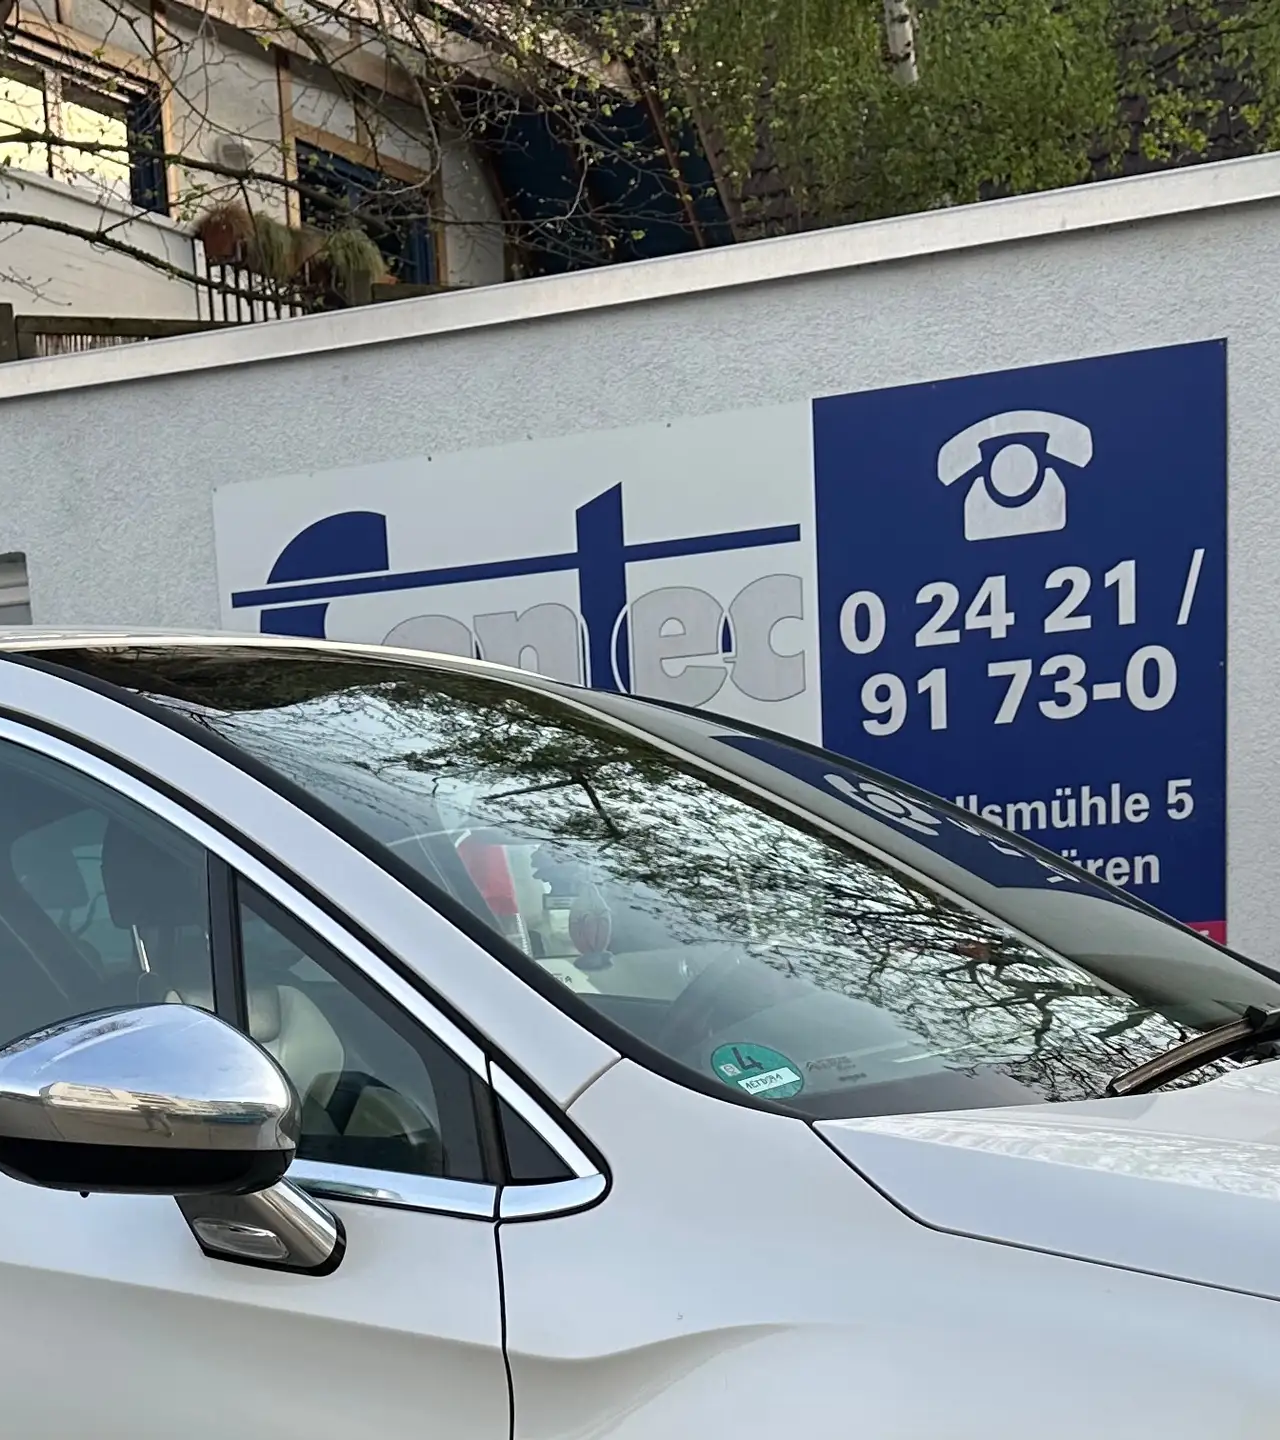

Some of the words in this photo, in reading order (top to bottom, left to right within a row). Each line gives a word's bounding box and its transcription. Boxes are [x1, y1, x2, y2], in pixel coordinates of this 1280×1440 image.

[839, 590, 886, 654] 0
[915, 575, 1015, 648] 24
[1044, 558, 1136, 634] 21
[1176, 548, 1206, 626] /
[860, 667, 947, 737] 91
[987, 644, 1178, 725] 73-0
[1166, 777, 1195, 821] 5
